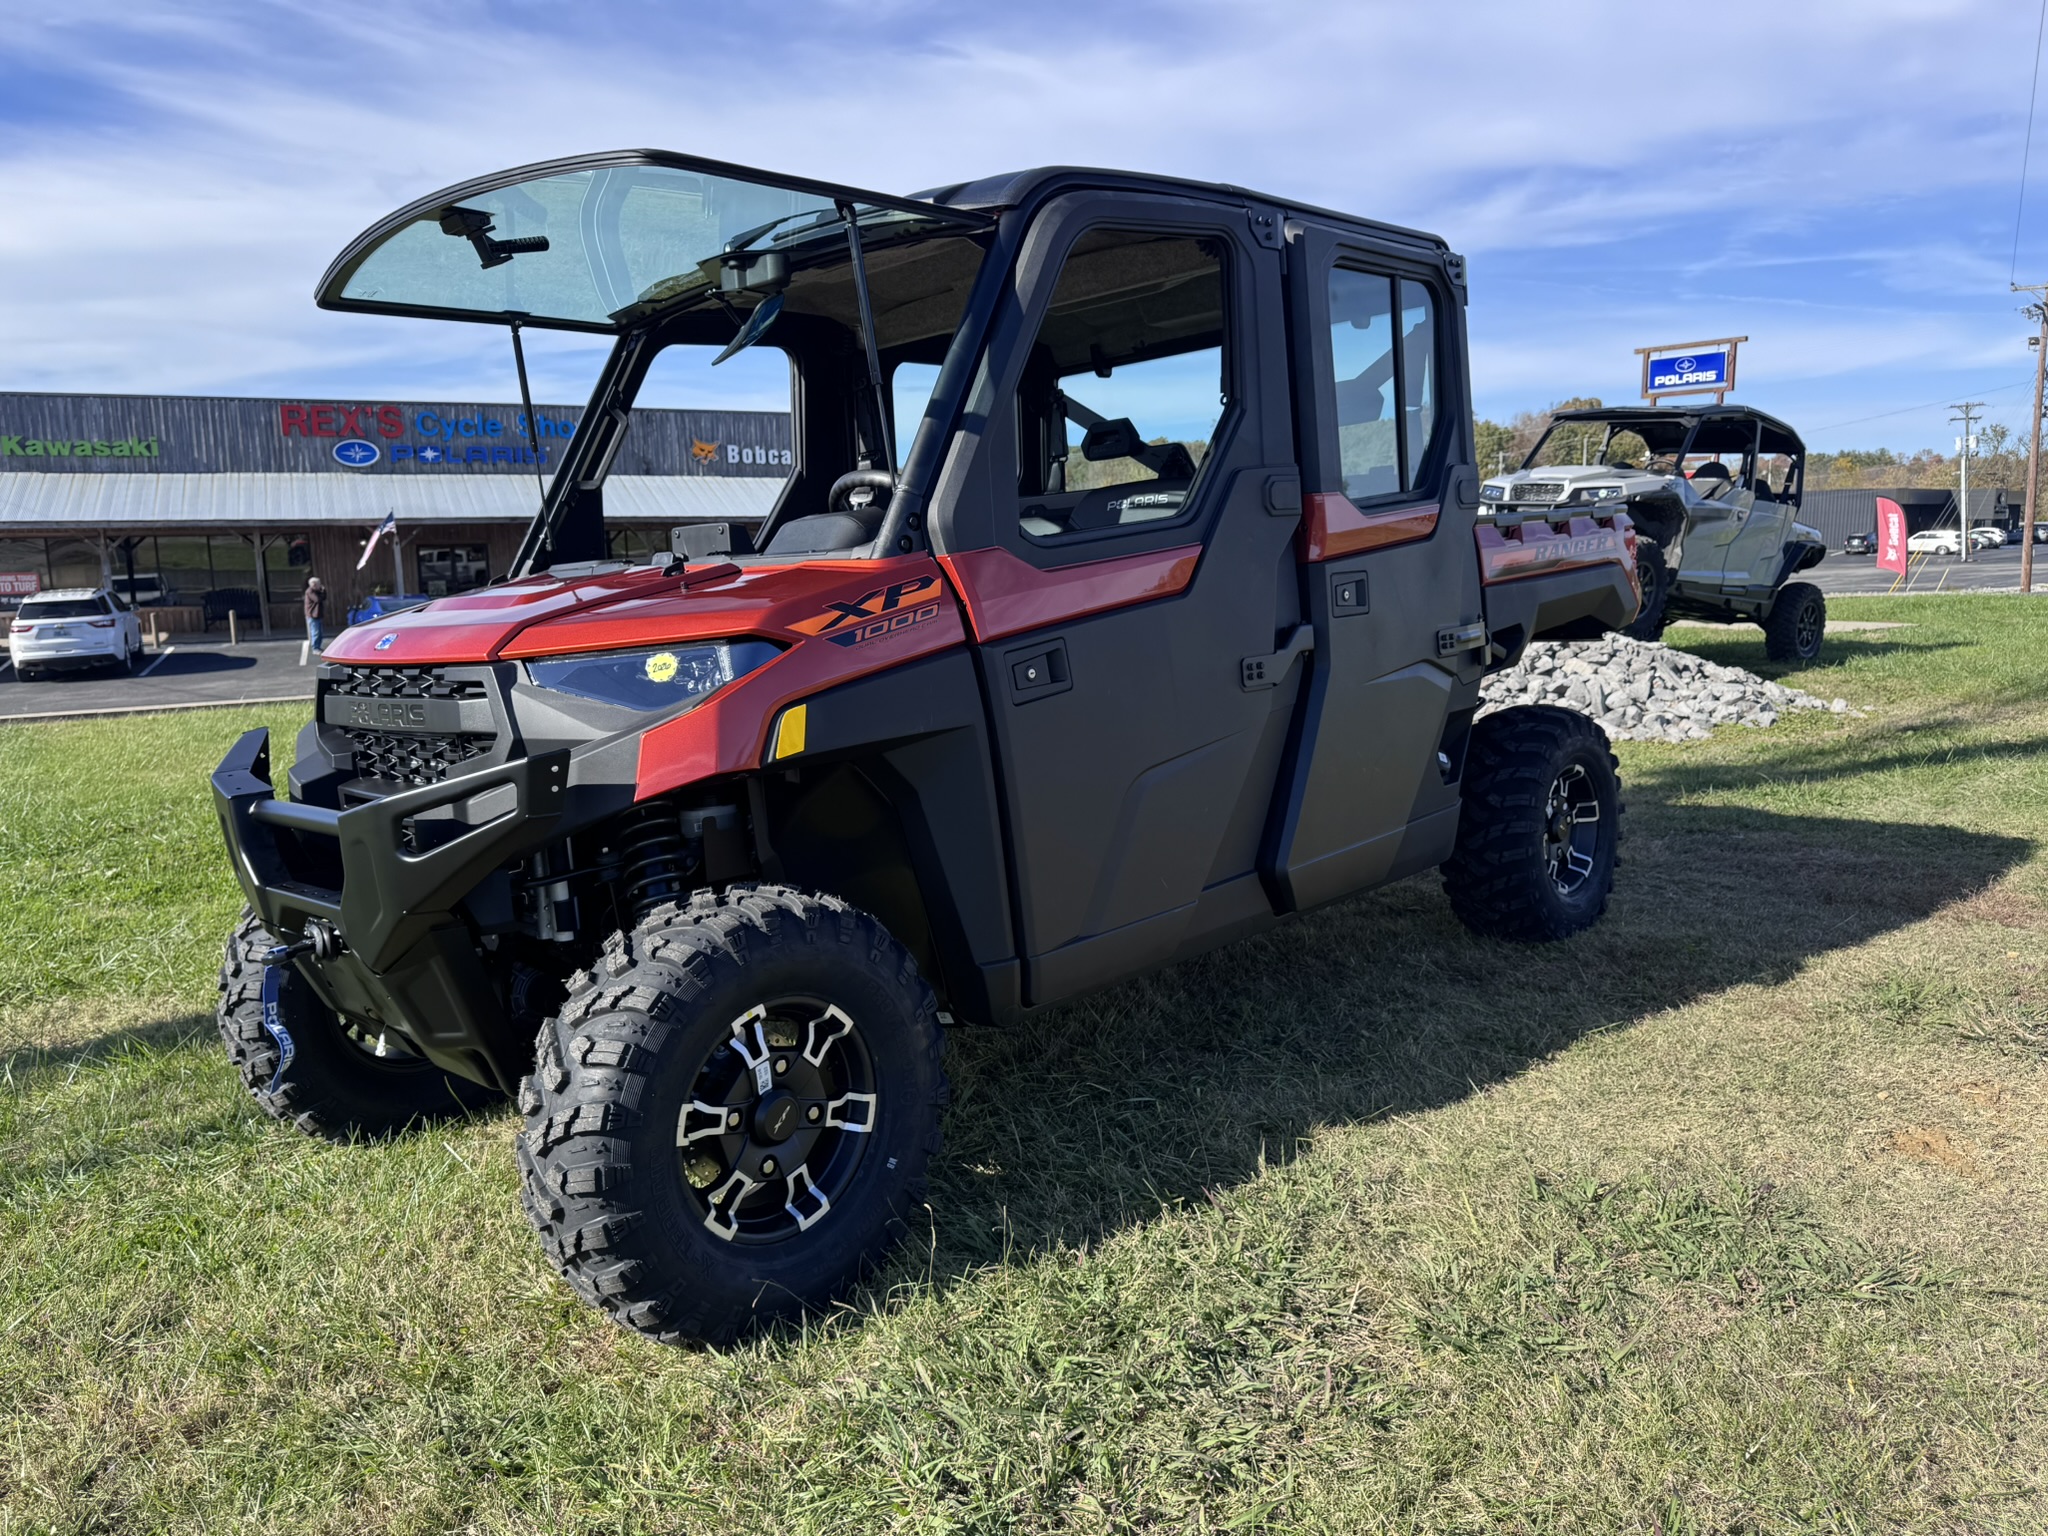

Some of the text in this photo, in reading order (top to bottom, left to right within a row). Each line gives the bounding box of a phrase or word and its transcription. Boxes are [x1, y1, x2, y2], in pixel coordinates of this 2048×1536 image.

[1654, 370, 1717, 386] POLARIS
[279, 404, 577, 441] REX'S Cycle Sho
[1, 435, 159, 458] Kawasaki
[390, 444, 548, 465] POLARIS
[727, 444, 792, 465] Bobca
[1107, 494, 1169, 511] POLARIS
[1534, 536, 1609, 561] RANGER
[12, 581, 38, 593] TURF
[816, 574, 937, 633] XP
[854, 603, 940, 643] 1000
[349, 702, 426, 728] POLARIS
[266, 1001, 296, 1073] POLARIS
